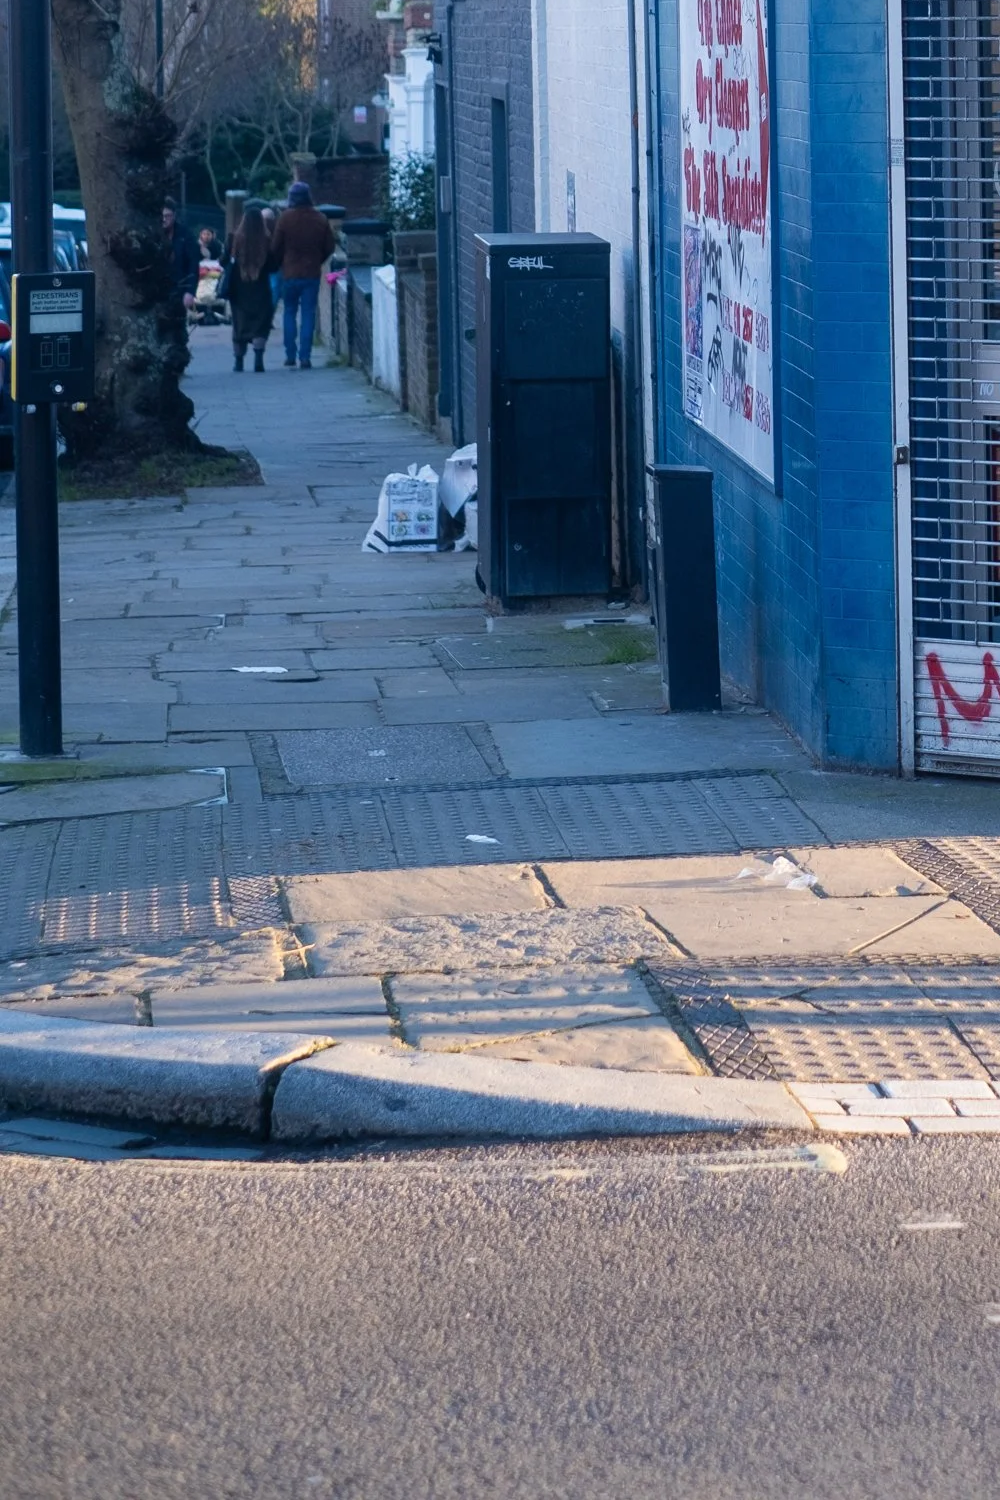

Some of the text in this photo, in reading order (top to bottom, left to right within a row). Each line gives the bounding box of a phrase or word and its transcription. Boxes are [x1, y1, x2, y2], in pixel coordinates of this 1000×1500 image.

[695, 57, 750, 147] Dry Cleaners
[979, 382, 994, 396] NO
